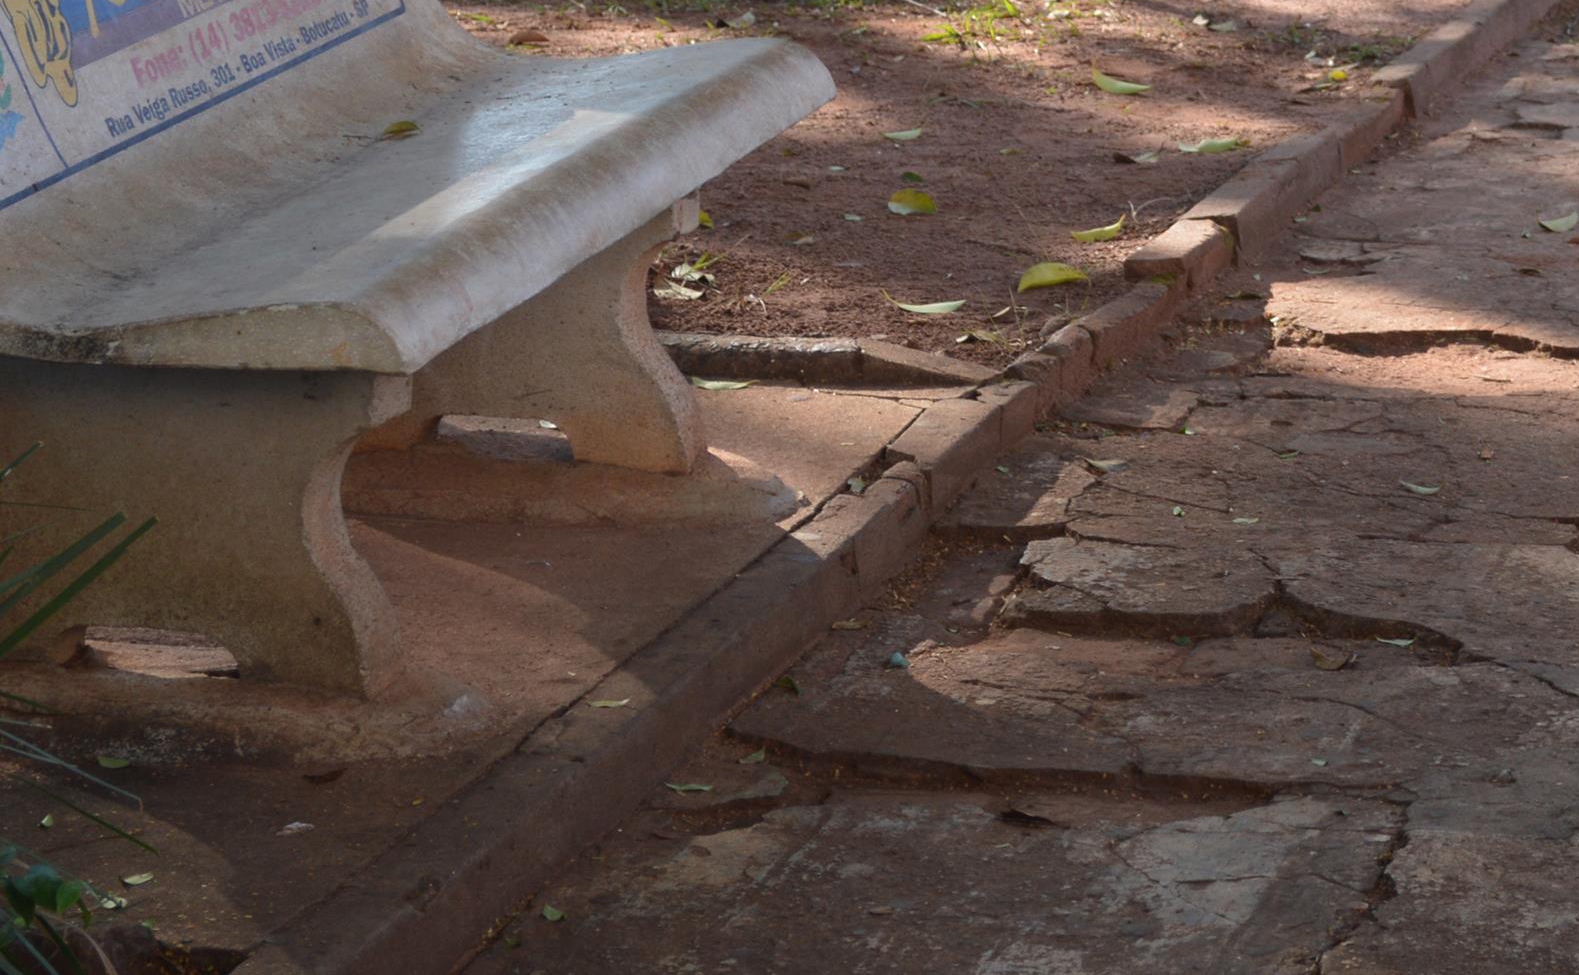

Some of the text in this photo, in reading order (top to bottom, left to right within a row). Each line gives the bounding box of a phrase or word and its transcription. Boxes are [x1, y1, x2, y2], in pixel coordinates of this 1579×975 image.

[104, 112, 135, 138] Rua
[132, 96, 171, 125] Veiga
[168, 78, 212, 109] Russo,
[210, 62, 236, 88] 301
[240, 50, 268, 74] Boa
[263, 36, 296, 62] Vista
[299, 10, 351, 45] Botucatu
[130, 45, 189, 88] Fone:
[188, 20, 230, 66] (14)
